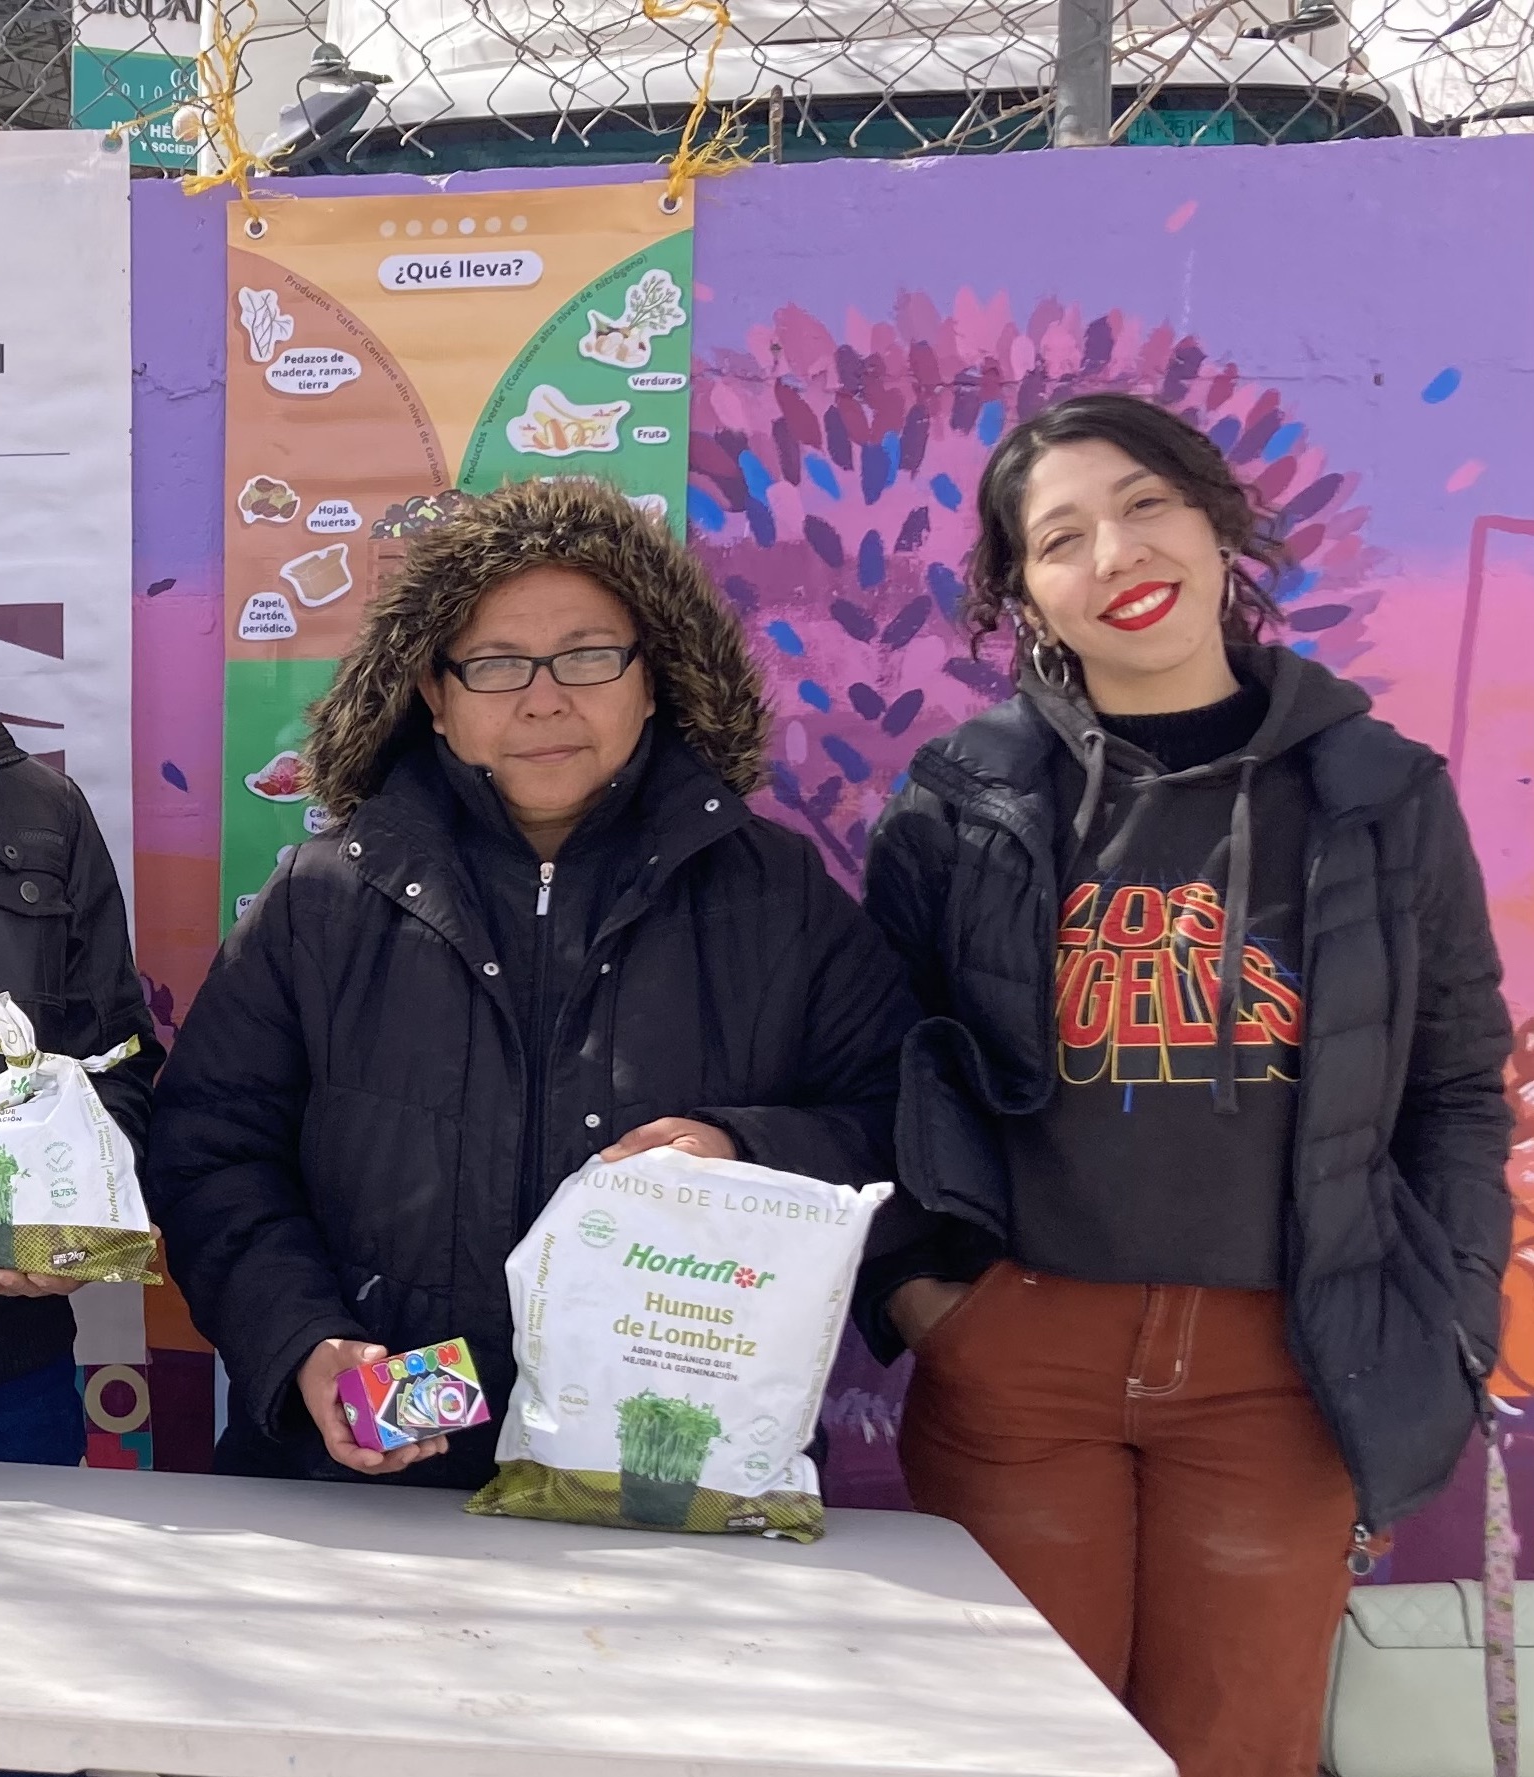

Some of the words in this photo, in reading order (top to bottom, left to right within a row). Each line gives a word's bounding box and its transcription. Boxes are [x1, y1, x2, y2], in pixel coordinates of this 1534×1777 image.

[394, 259, 452, 285] ¿Qué
[459, 258, 524, 278] lleva?
[284, 353, 328, 365] Pedazos
[330, 352, 344, 363] de
[271, 367, 317, 378] madera,
[319, 366, 357, 377] ramas,
[462, 430, 488, 486] Productos
[505, 342, 541, 391] (Contiene
[539, 323, 558, 344] alto
[556, 301, 581, 325] nivel
[579, 289, 594, 303] de
[594, 253, 649, 292] nitrógeno)
[284, 274, 332, 312] Productos
[360, 337, 398, 382] (Contiene
[395, 382, 411, 402] alto
[408, 403, 423, 429] nivel
[419, 429, 430, 444] de
[425, 446, 444, 487] carbón)
[298, 380, 329, 390] tierra
[631, 376, 683, 387] Verduras
[637, 429, 667, 439] Fruta
[318, 505, 349, 517] Hojas
[310, 518, 356, 528] muertas
[252, 598, 285, 611] Papel,
[248, 610, 288, 622] Cartón,
[242, 623, 294, 635] periódico.
[1056, 881, 1227, 948] LOS
[50, 1187, 78, 1198] 15.75%
[578, 1171, 665, 1200] HUMUS
[677, 1186, 712, 1207] DE
[724, 1192, 850, 1227] LOMBRIZ
[67, 1250, 86, 1262] 2kg
[622, 1242, 776, 1289] Hortaflor
[644, 1291, 735, 1325] Humus
[612, 1314, 645, 1338] de
[648, 1320, 757, 1358] Lombriz
[631, 1345, 663, 1358] ABONO
[664, 1351, 711, 1366] ORGÁNICO
[713, 1359, 733, 1370] QUE
[622, 1354, 658, 1368] MEJORA
[660, 1362, 672, 1371] LA
[674, 1364, 739, 1381] GERMINACIÓN
